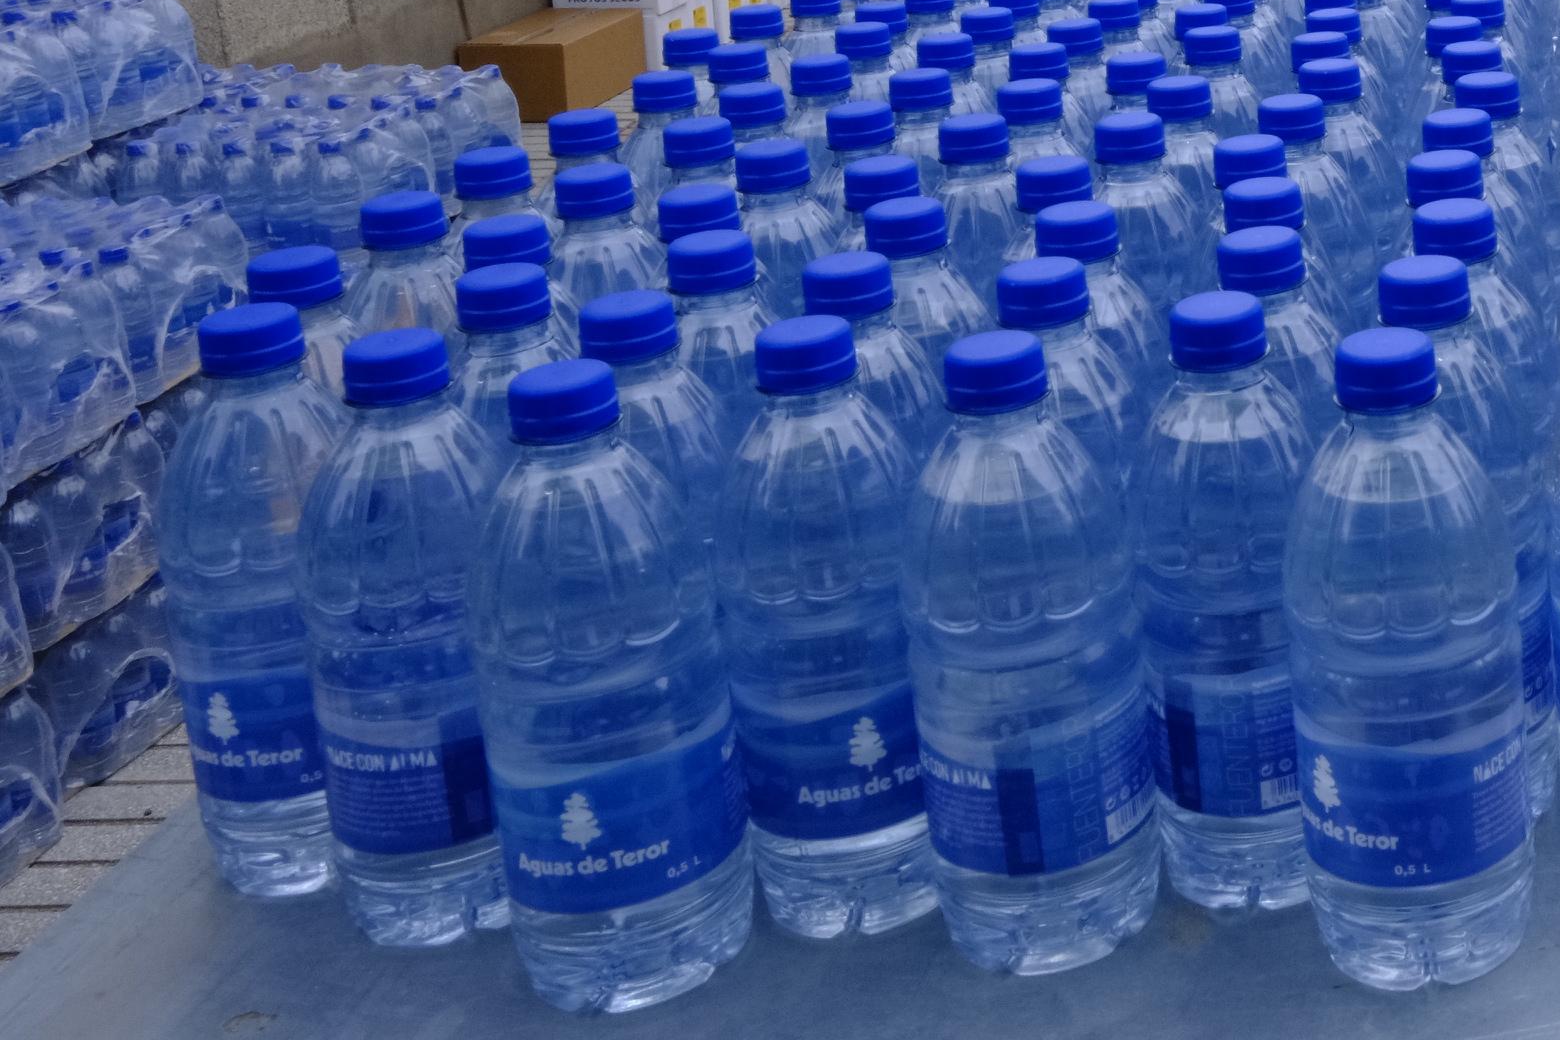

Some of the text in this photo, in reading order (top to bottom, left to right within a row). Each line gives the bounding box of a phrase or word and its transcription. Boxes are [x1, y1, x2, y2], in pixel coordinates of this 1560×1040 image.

[221, 750, 245, 767] de
[245, 748, 302, 767] Teror
[798, 764, 921, 807] Aguas de Ter
[1322, 819, 1345, 842] de
[1345, 824, 1399, 851] Teror
[519, 840, 670, 877] Aguas de Teror
[667, 855, 701, 878] 0,5 L
[1394, 863, 1432, 877] 0,5 L
